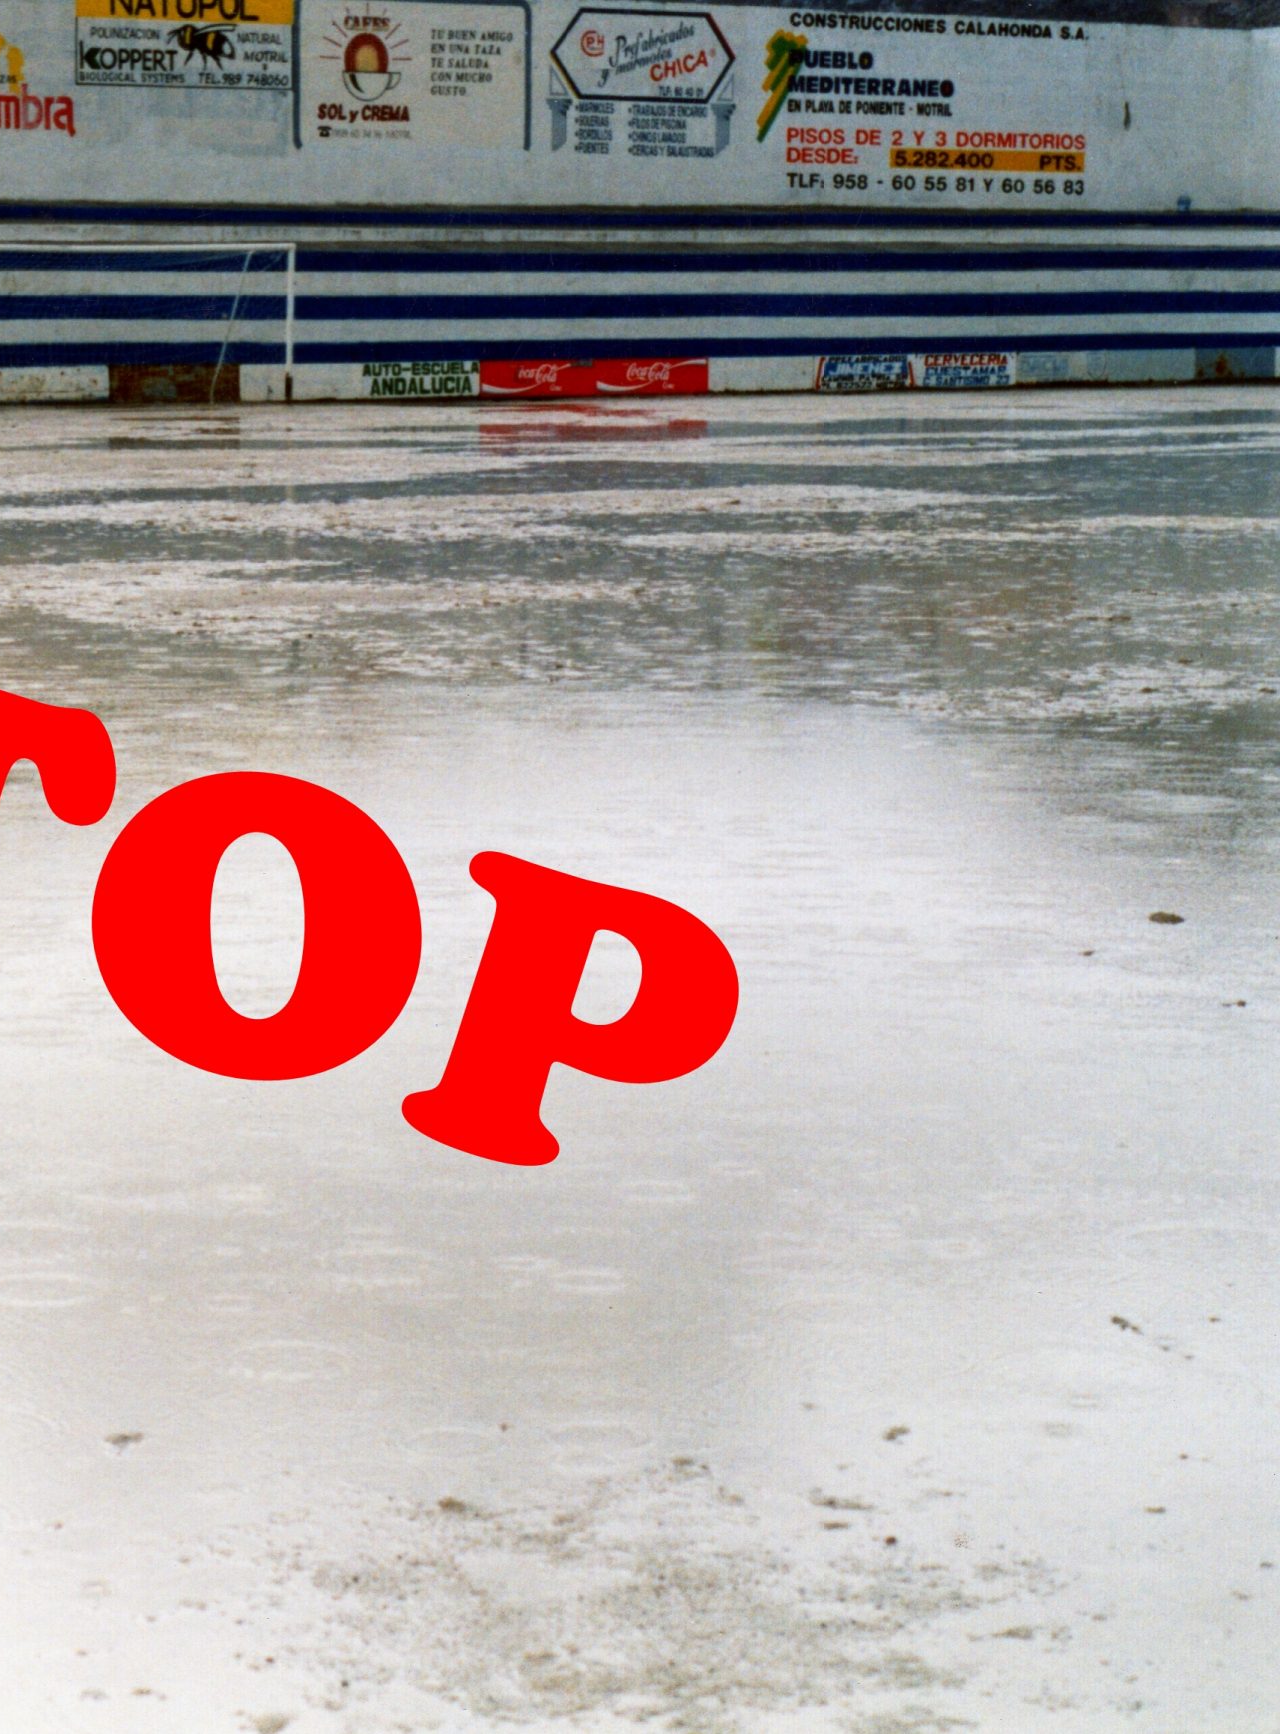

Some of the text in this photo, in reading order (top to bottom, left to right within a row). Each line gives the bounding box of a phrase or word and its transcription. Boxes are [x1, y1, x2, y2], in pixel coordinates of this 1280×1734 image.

[790, 12, 1089, 41] CONSTRUCCIONES CALAHONDA S.A.
[90, 27, 282, 45] POLINIZACION NATURAL
[431, 29, 513, 42] TU BUEN AMIGO
[243, 51, 289, 64] MOTRIL
[431, 43, 501, 56] EN UNA TAZA
[431, 58, 489, 69] TE SALUDA
[650, 50, 708, 82] CHICA
[788, 50, 874, 70] PUEBLO
[80, 72, 185, 84] BIOLOGICAL SYSTEMS
[431, 72, 492, 83] CON MUCHO
[431, 86, 467, 96] GUSTO
[787, 75, 955, 98] MEDITERRANEO
[318, 104, 410, 123] SOL y CREMA
[787, 100, 801, 112] EN
[805, 100, 835, 113] PLAYA
[839, 101, 852, 114] DE
[856, 102, 905, 116] PONIENTE
[917, 103, 953, 117] MOTRIL
[786, 127, 1085, 150] PISOS DE 2 Y 3 DORMITORIOS
[786, 147, 1081, 171] DESDE: 5.282.400 PTS.
[832, 174, 869, 190] 958
[892, 175, 916, 191] 60
[924, 176, 949, 191] 55
[956, 177, 975, 192] 81
[983, 176, 993, 192] Y
[1001, 178, 1025, 194] 60
[1033, 179, 1056, 195] 56
[1064, 180, 1085, 195] 83
[363, 361, 480, 377] AUTO-ESCUELA
[924, 354, 1008, 367] CERVECERIA
[370, 376, 472, 396] ANDALUCIA
